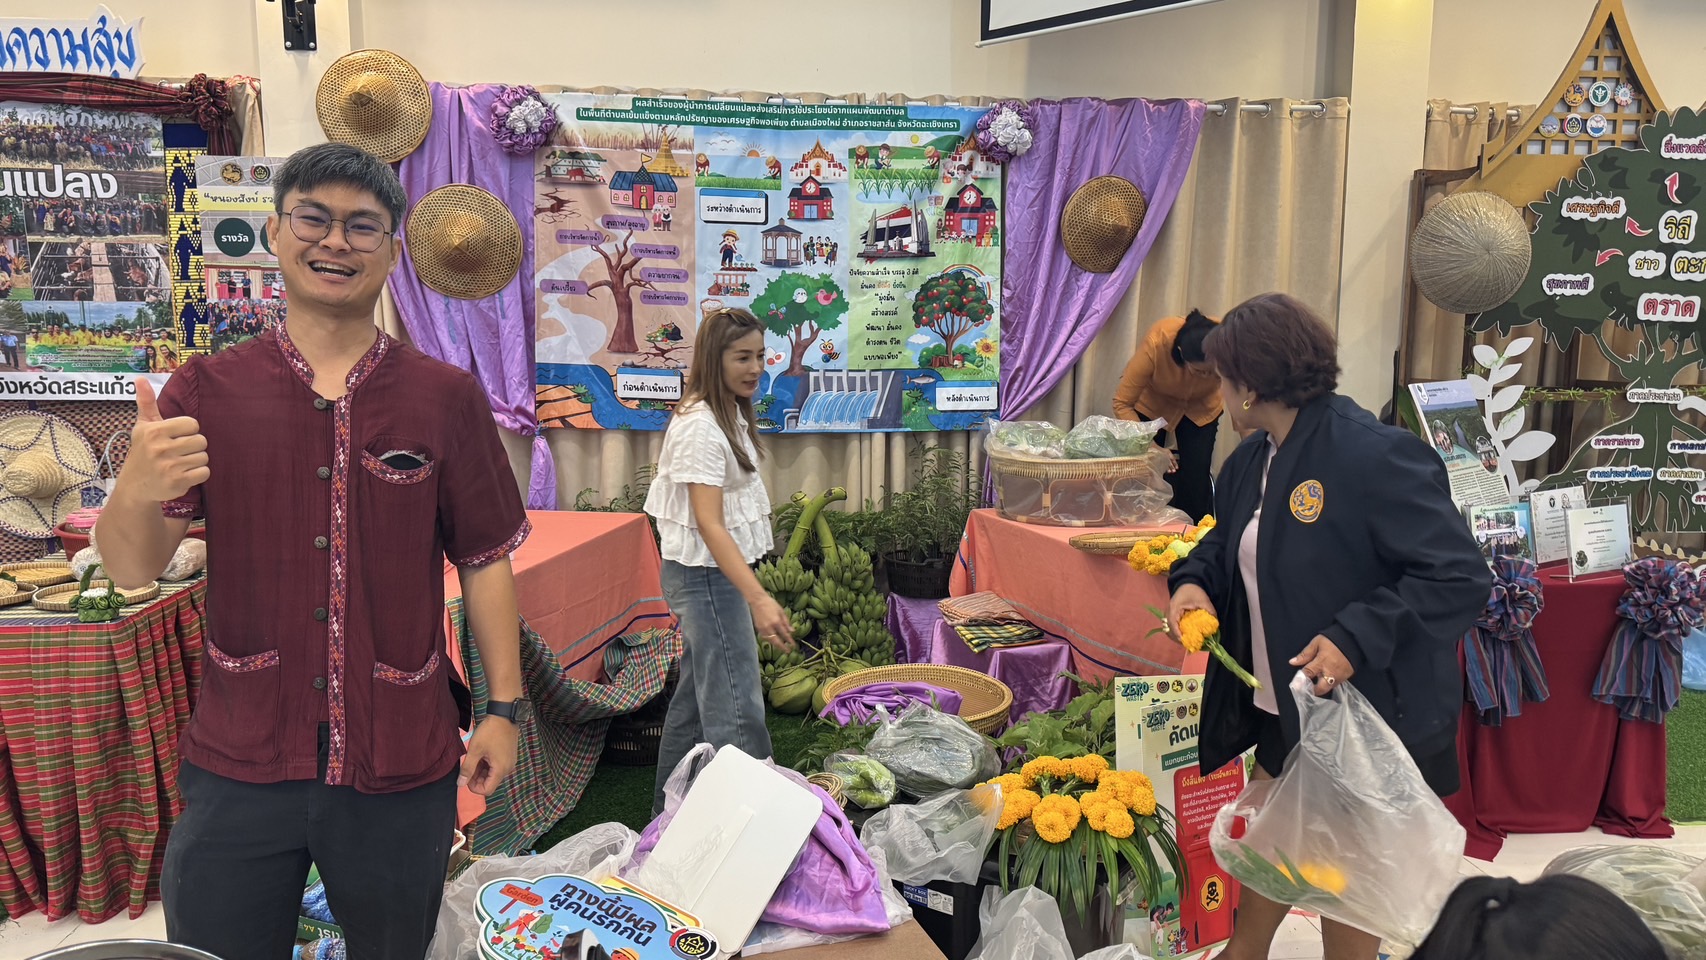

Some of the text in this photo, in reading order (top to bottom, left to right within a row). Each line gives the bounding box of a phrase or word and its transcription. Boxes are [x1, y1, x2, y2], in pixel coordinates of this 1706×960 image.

[0, 14, 137, 78] ความสุข
[579, 107, 958, 129] ในพื้นที่ตำบลเข้มแข็งตามหลักปรัชญาของเศรษฐกิจพอเพียง ตำบลเมืองใหม่ อำเภอราชสาส์น จังหวัดฉะเชิงเทรา
[706, 203, 762, 215] ระหว่างดำเนินการ
[1566, 200, 1620, 217] เศรษฐกิจดี
[1664, 215, 1692, 240] วิถี
[221, 232, 249, 243] รางวัล
[1635, 256, 1660, 271] ชาว
[647, 271, 681, 280] ความยากจน
[1546, 277, 1590, 292] สุขภาพดี
[1643, 298, 1696, 317] ตราด
[622, 381, 678, 393] ก่อนดำเนินการ
[946, 393, 990, 402] หลังดำเนินการ
[1121, 681, 1150, 698] ZERO
[1126, 695, 1143, 703] WASTE
[1146, 708, 1171, 728] ZERO
[506, 886, 538, 904] Garden
[560, 883, 657, 934] ทางนี้มีผล
